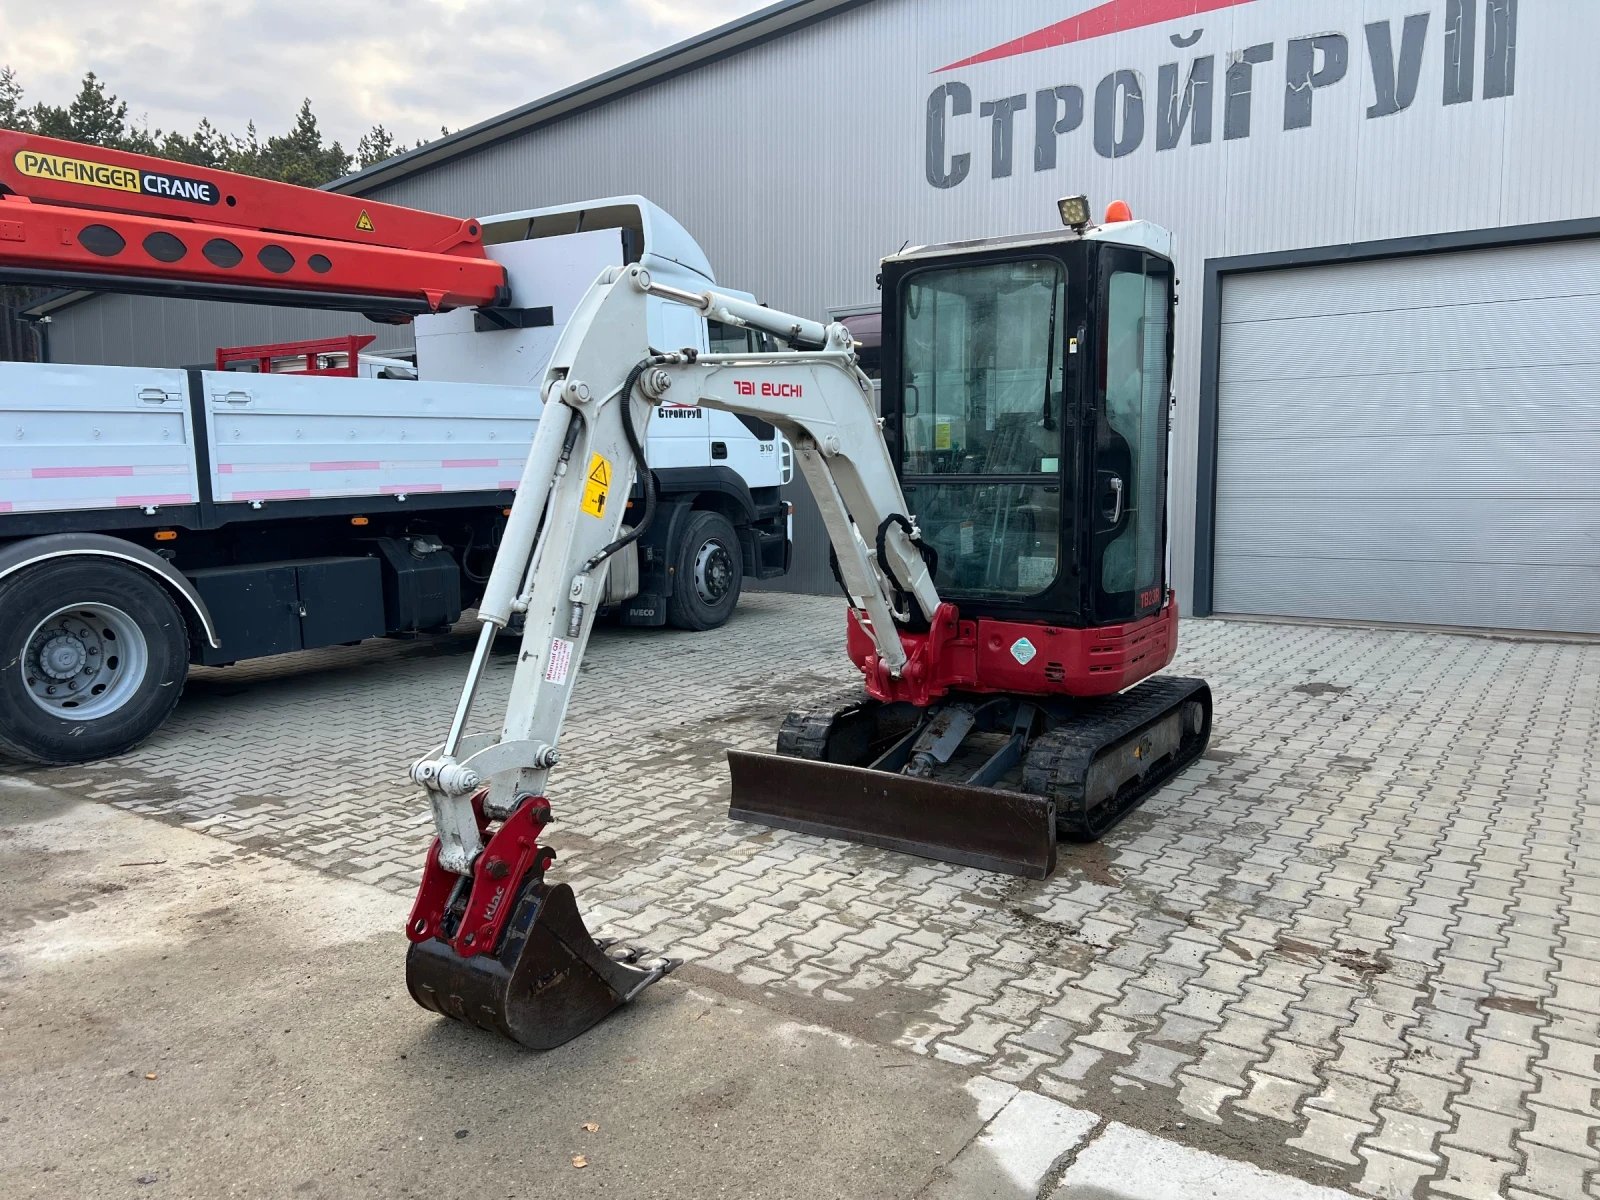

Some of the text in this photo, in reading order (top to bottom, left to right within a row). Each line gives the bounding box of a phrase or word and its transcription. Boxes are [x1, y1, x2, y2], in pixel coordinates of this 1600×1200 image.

[23, 154, 211, 202] PALFINGER CRANE
[630, 608, 655, 617] IVECO
[546, 640, 559, 680] Manual QH
[483, 885, 504, 920] Klac
